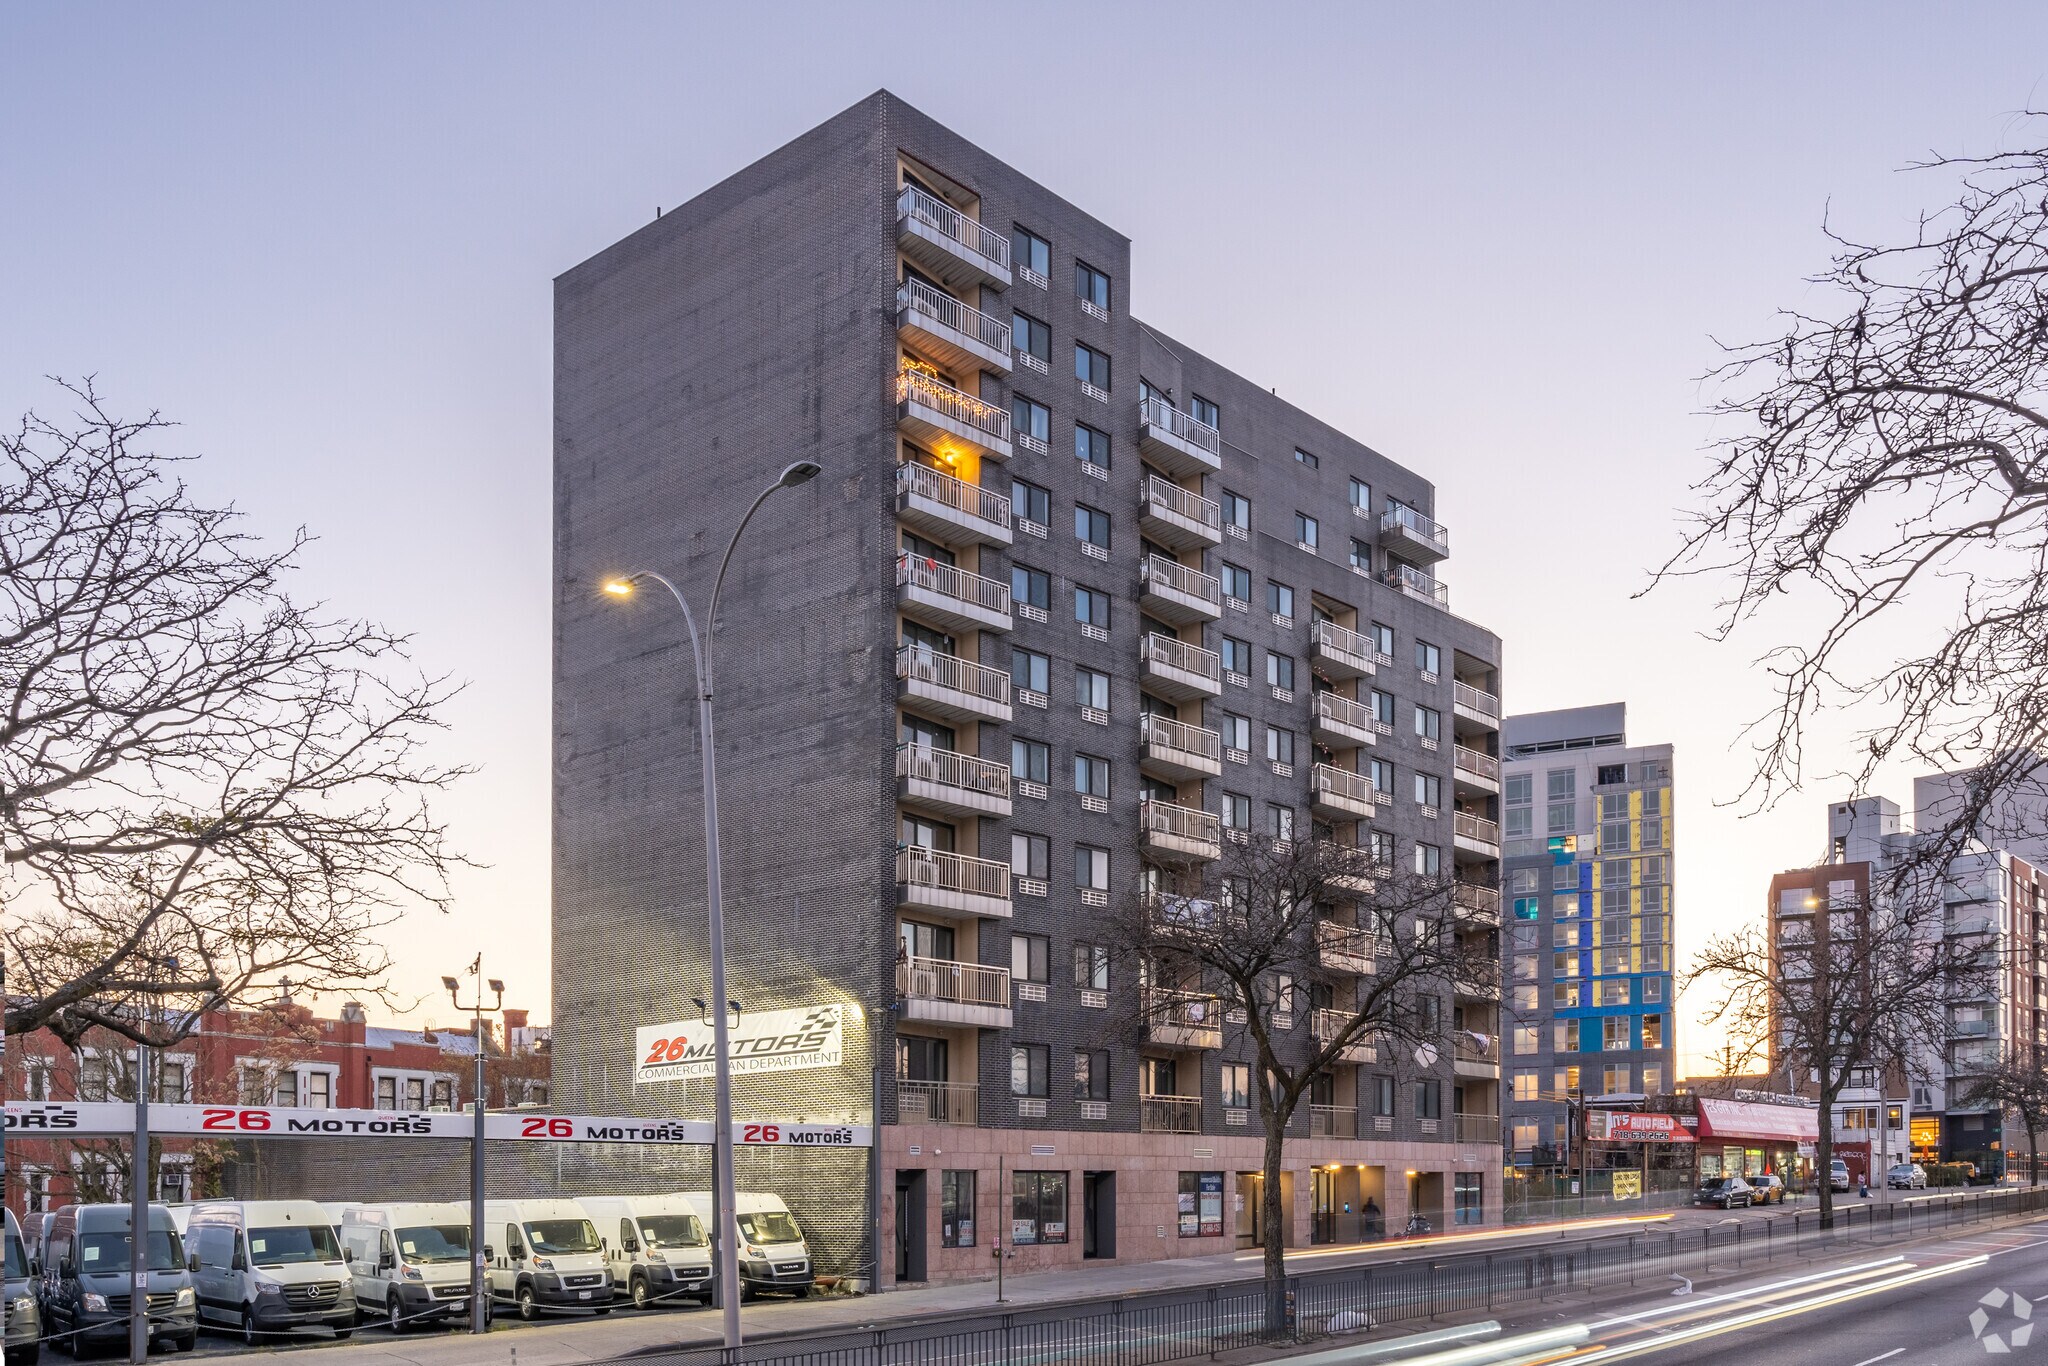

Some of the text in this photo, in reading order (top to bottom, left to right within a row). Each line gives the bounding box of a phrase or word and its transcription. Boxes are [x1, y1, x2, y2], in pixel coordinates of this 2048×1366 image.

[645, 1036, 687, 1063] 26
[638, 1062, 716, 1080] COMMERCIAL
[750, 1051, 840, 1070] DEPARTMENT
[202, 1109, 432, 1134] 26 MOTORS
[521, 1118, 684, 1141] 26 MOTORS
[1631, 1116, 1651, 1130] AUTO
[1652, 1117, 1674, 1130] FIELD
[743, 1125, 852, 1144] 26 MOTORS
